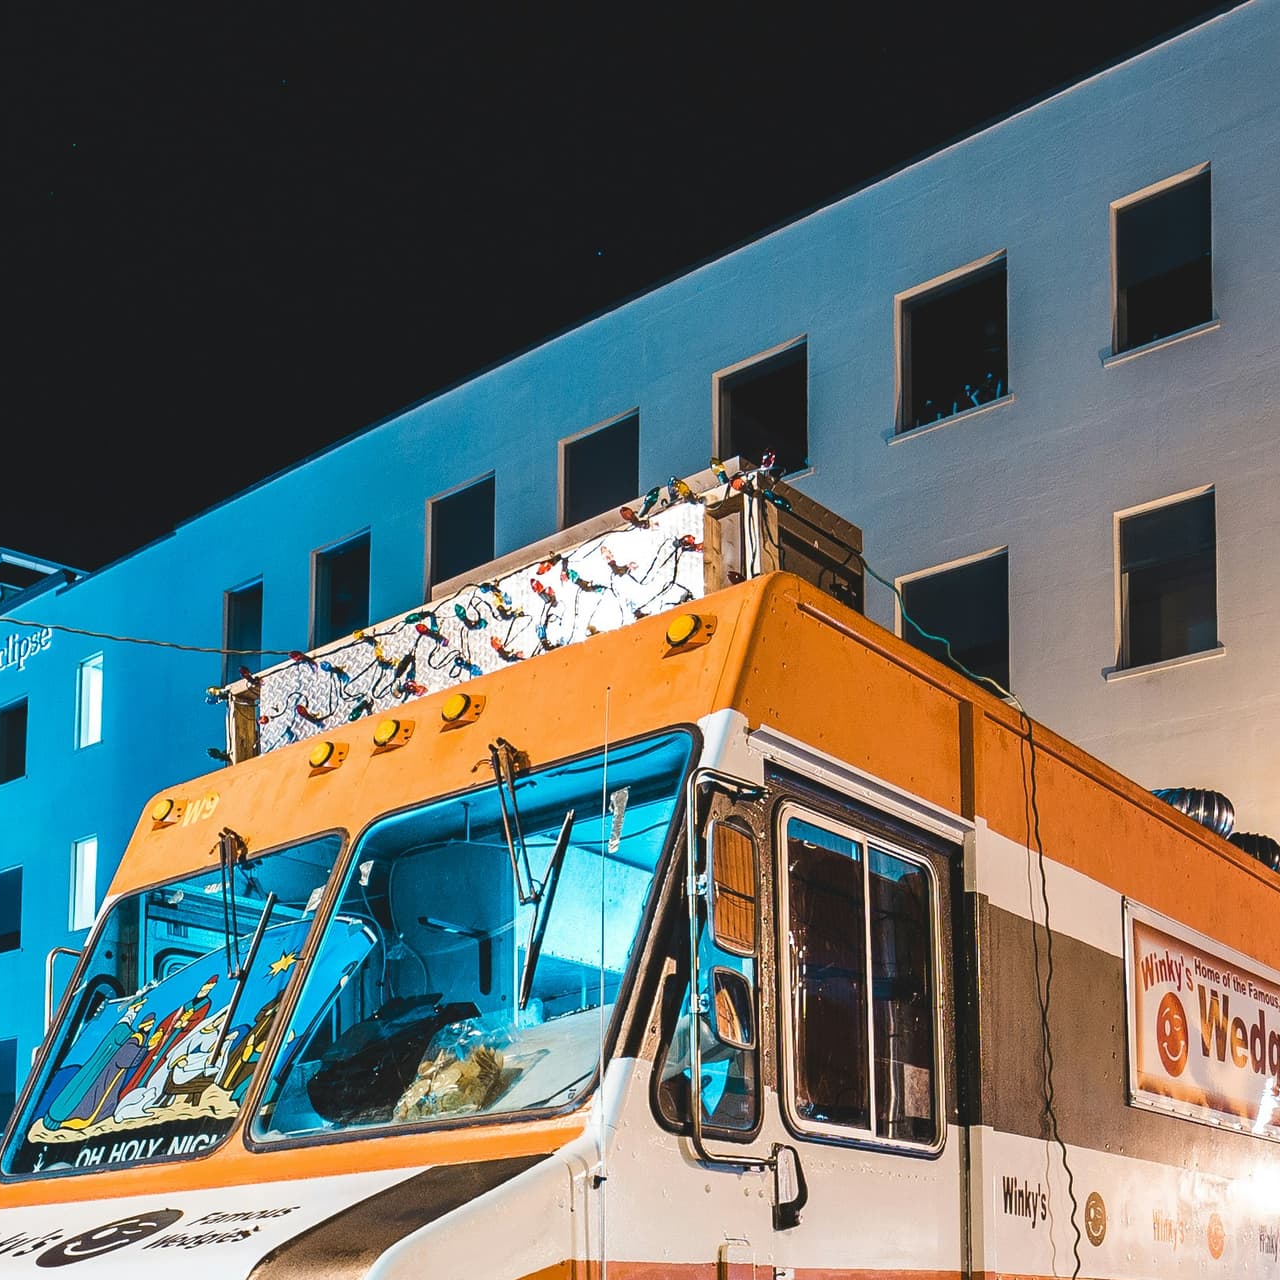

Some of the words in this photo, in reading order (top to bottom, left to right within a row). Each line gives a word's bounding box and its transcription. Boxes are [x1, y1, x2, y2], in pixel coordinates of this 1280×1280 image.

[1141, 951, 1193, 992] Winky's
[1194, 958, 1220, 984] Home
[1222, 972, 1231, 988] of
[1233, 978, 1246, 996] the
[75, 1148, 103, 1167] OH
[108, 1137, 164, 1163] HOLY
[186, 1206, 301, 1226] Famous
[1003, 1176, 1047, 1229] Winky's
